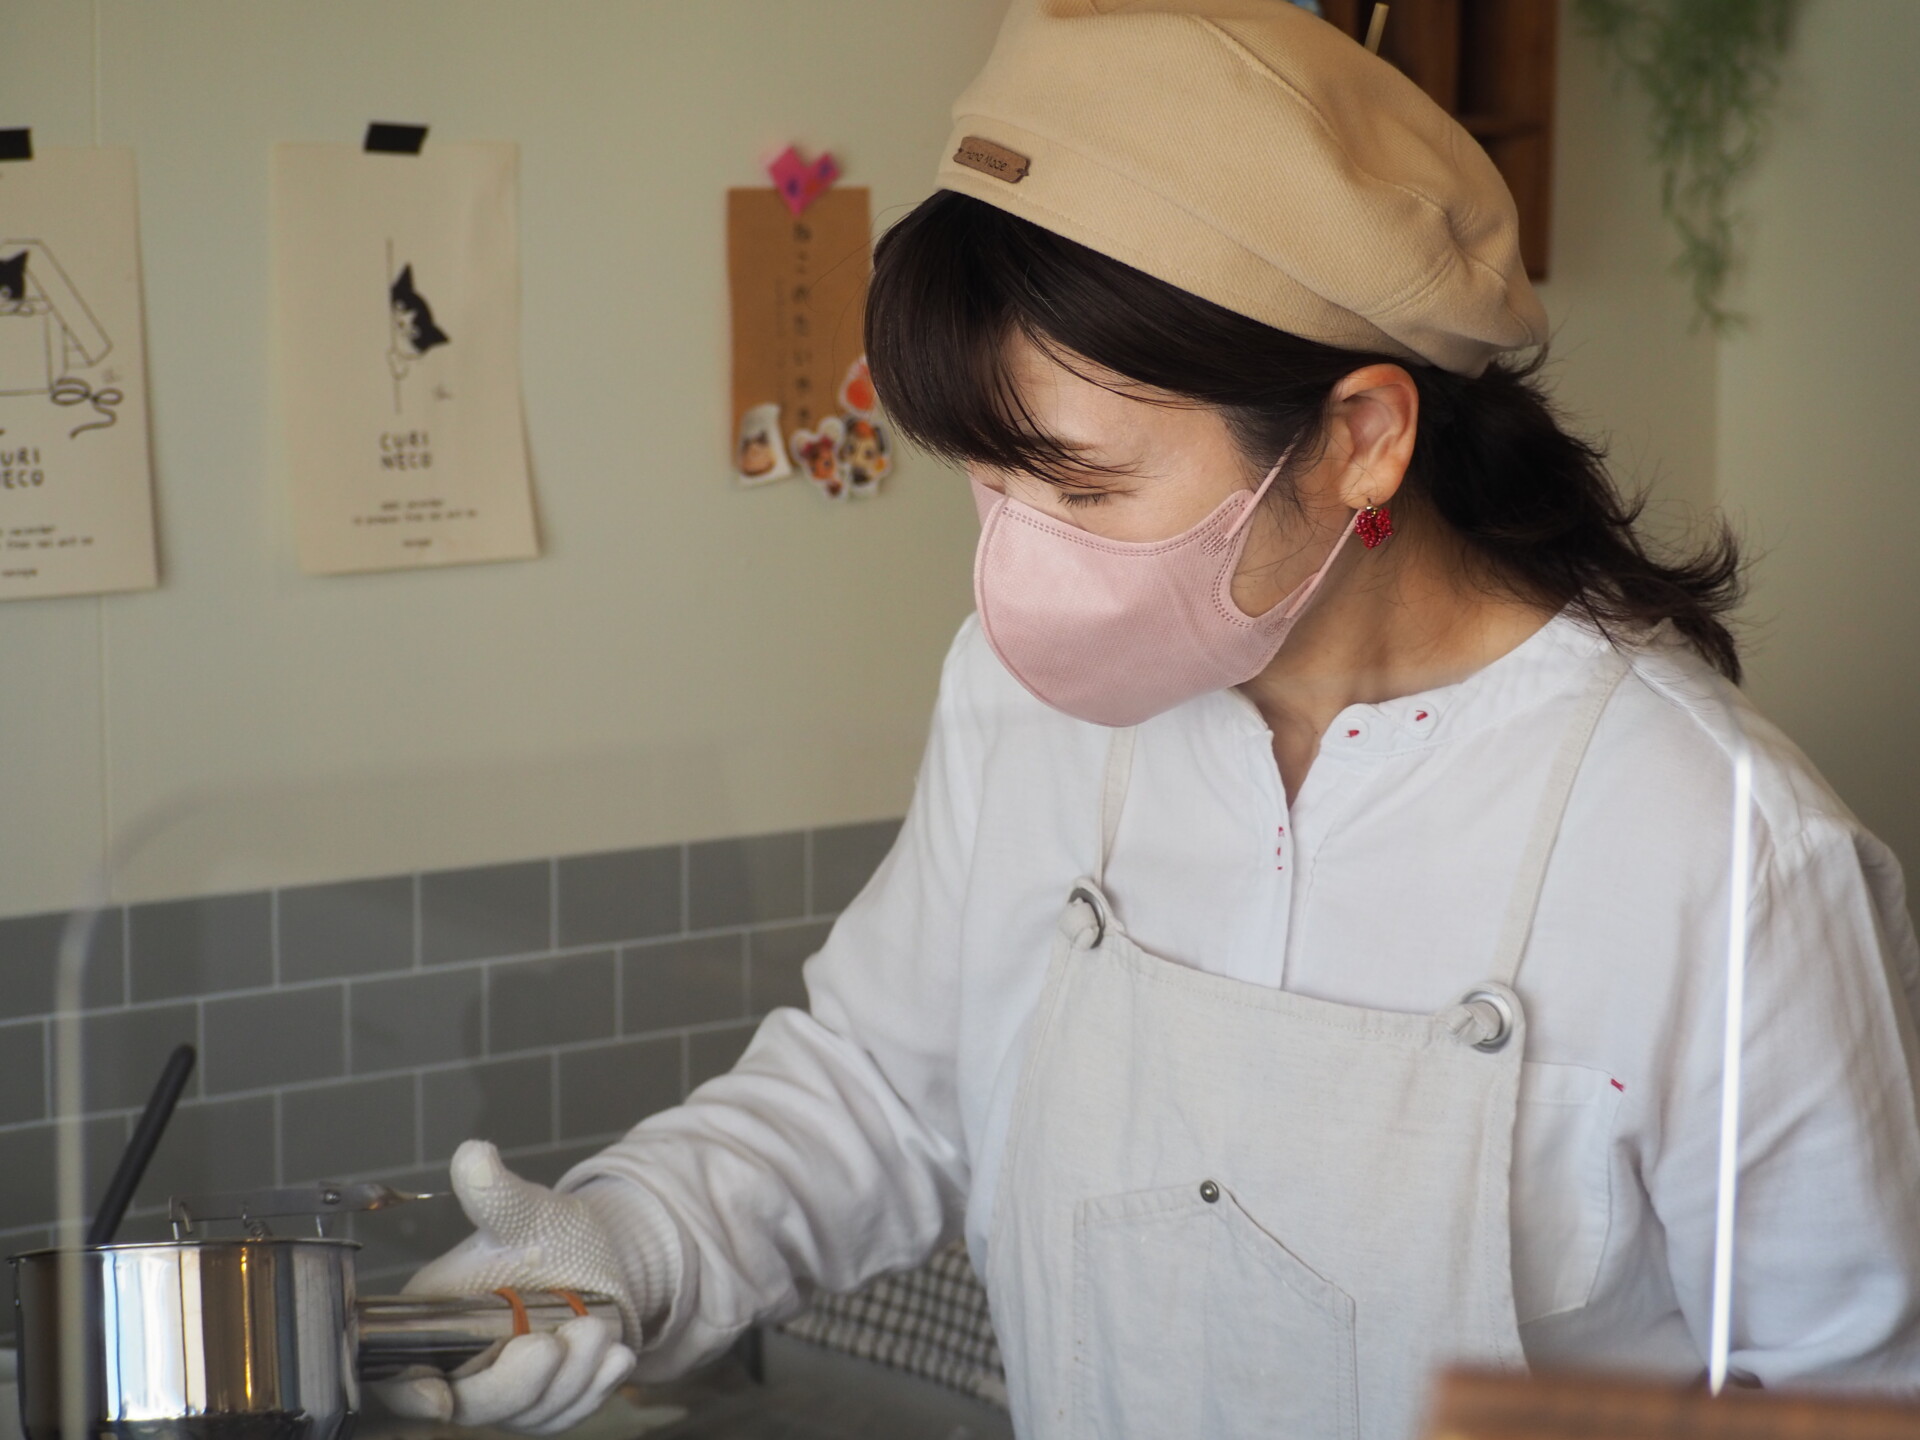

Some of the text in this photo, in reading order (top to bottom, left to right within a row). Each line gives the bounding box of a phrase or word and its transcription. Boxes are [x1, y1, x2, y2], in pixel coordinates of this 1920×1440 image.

[379, 430, 430, 452] CURI
[0, 447, 41, 468] URI
[0, 469, 45, 490] ECO
